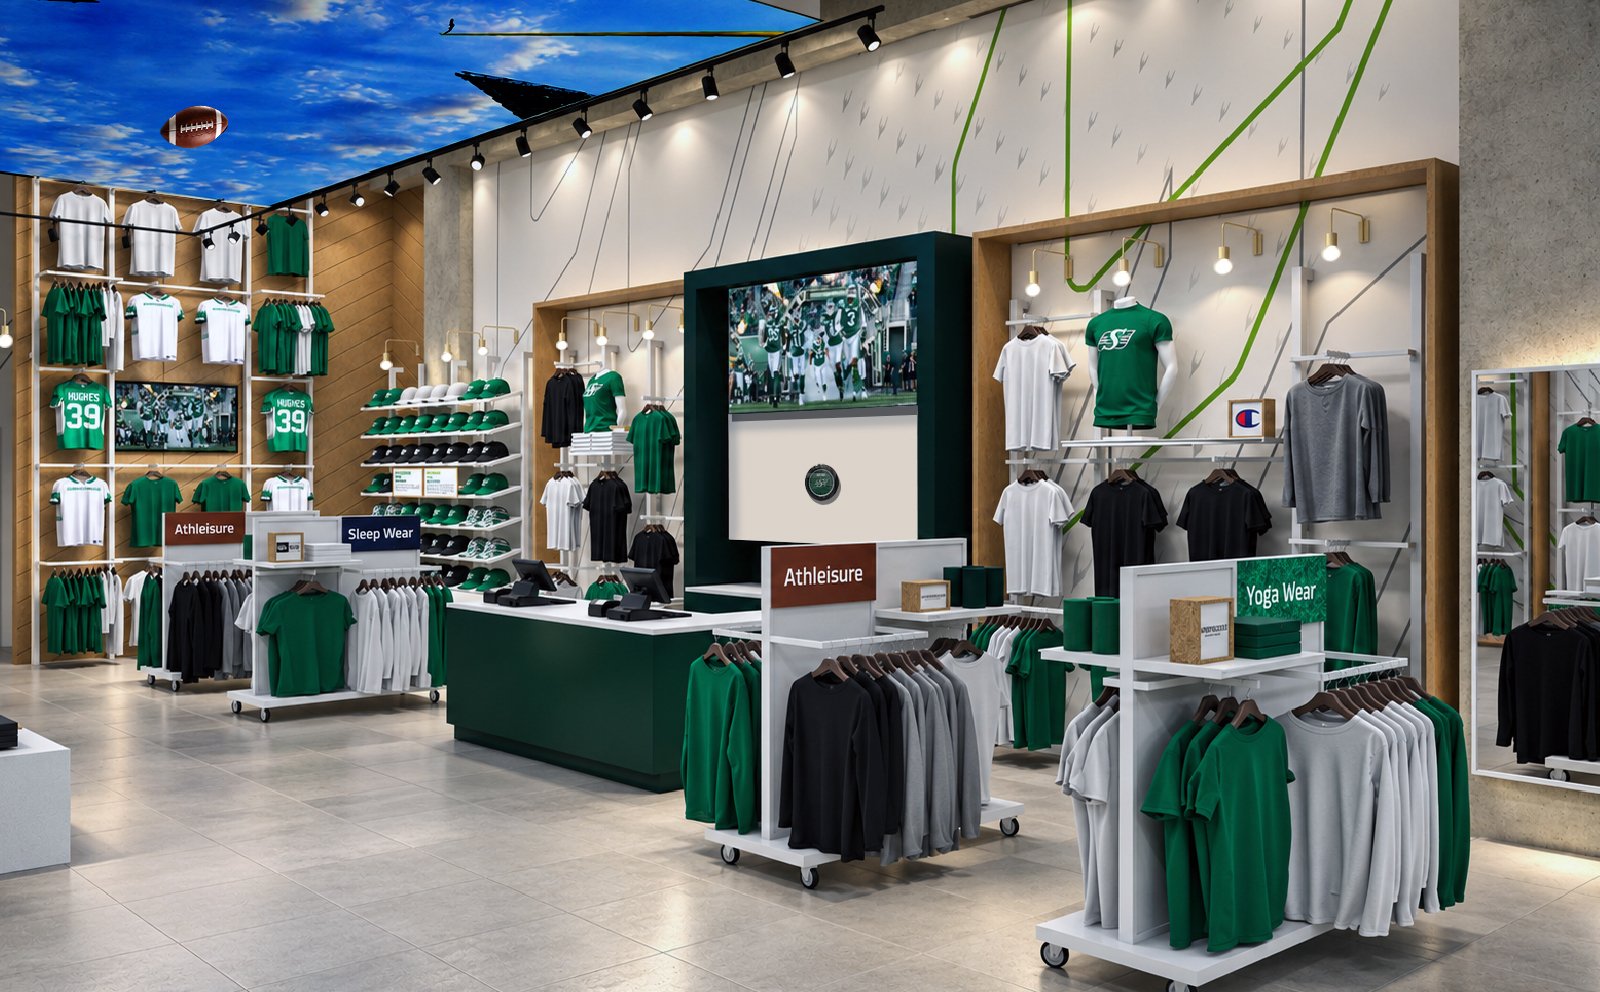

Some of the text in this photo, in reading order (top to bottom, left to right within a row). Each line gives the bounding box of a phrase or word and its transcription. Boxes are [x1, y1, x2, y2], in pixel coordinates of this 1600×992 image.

[67, 391, 101, 403] HUGHES
[66, 402, 101, 430] 39
[276, 408, 306, 434] 39
[174, 522, 234, 535] Athleisure
[348, 527, 414, 542] Sleep Wear
[783, 565, 863, 588] Athleisure
[1246, 580, 1317, 610] Yoga Wear
